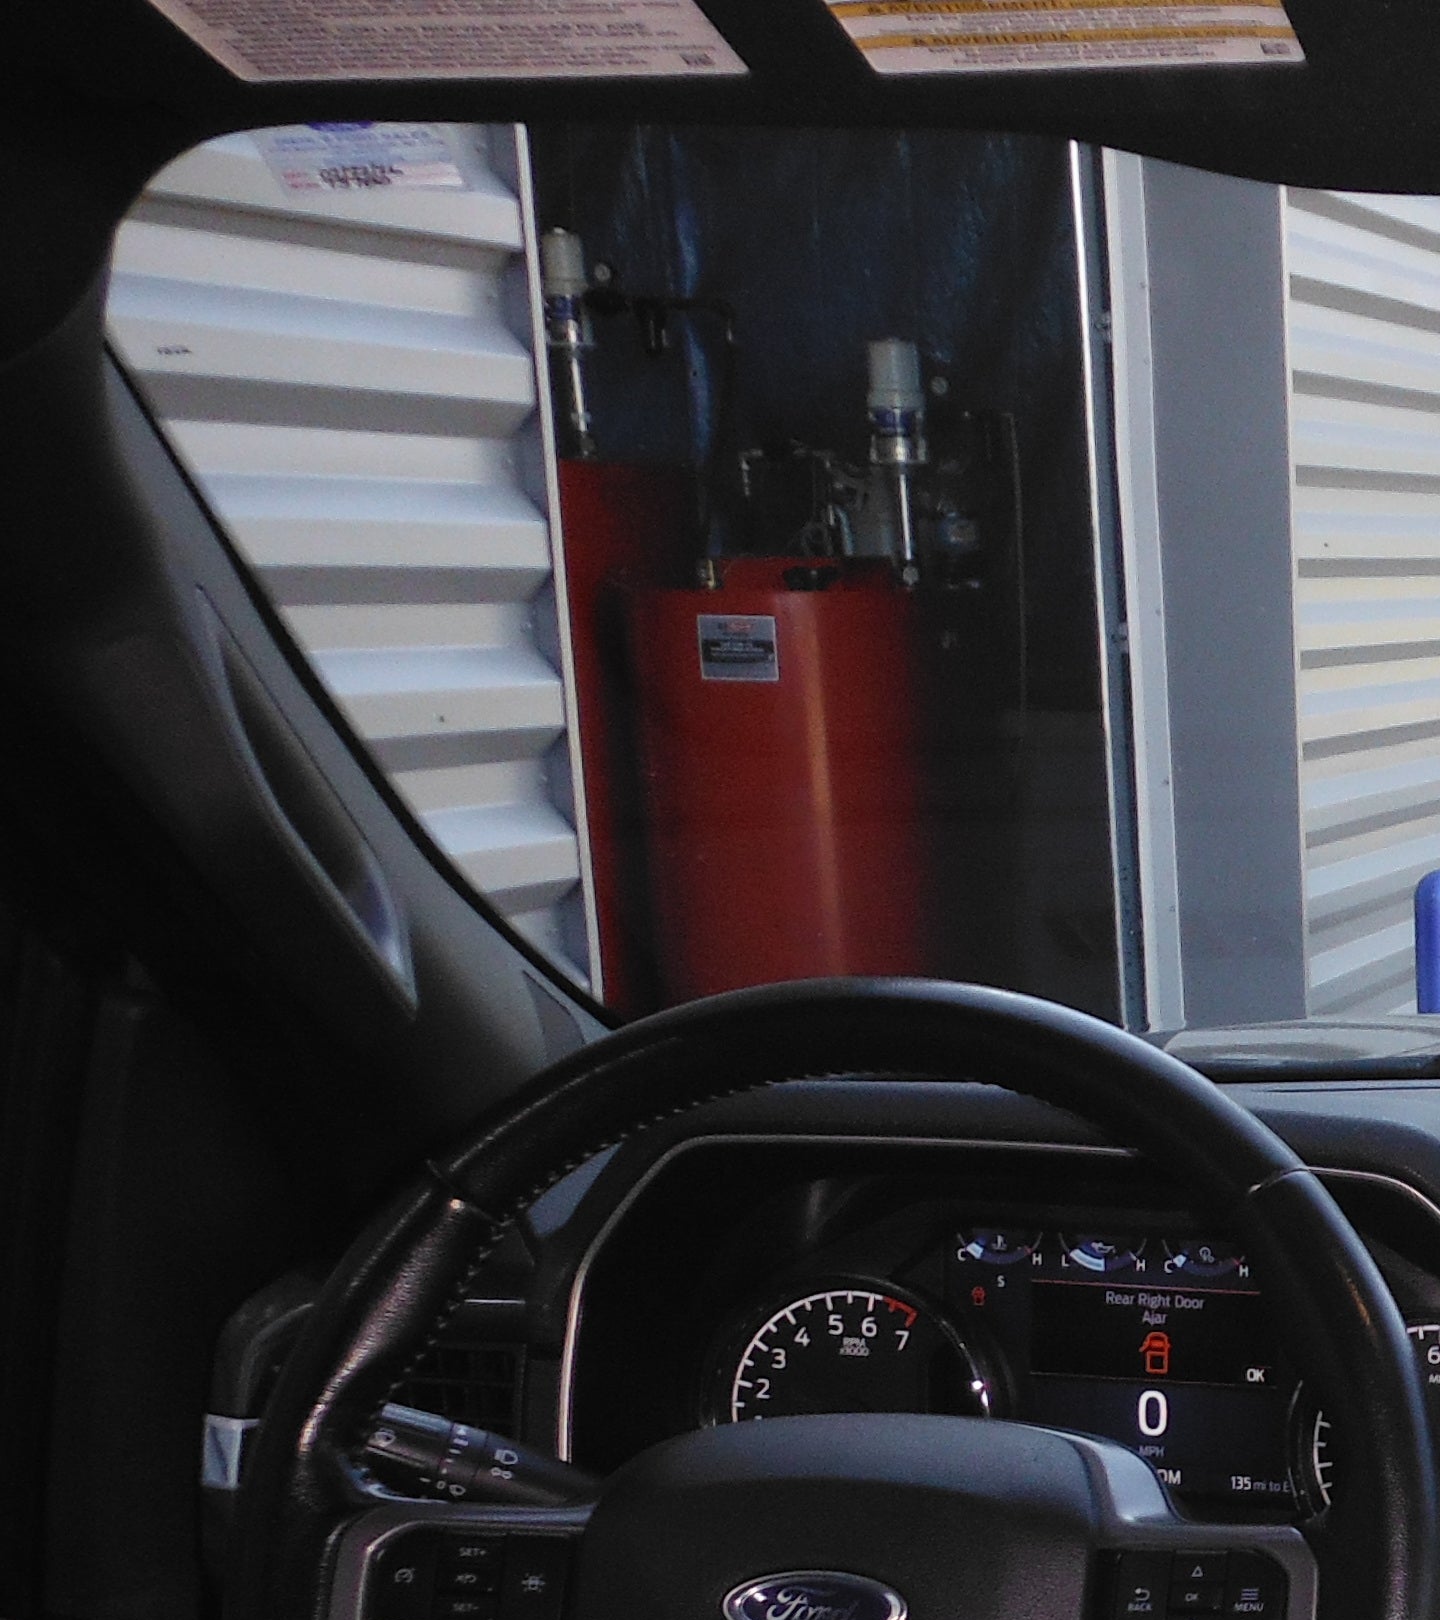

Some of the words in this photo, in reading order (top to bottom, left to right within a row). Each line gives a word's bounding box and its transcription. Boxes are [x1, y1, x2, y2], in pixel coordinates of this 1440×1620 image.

[957, 1248, 966, 1262] C
[1032, 1253, 1042, 1266] H
[1061, 1254, 1069, 1267] L
[1135, 1259, 1145, 1272] H
[1164, 1261, 1174, 1274] C
[1238, 1265, 1249, 1278] H
[1105, 1291, 1135, 1306] Rear
[1138, 1293, 1171, 1309] Right
[1174, 1294, 1205, 1310] Door
[828, 1315, 844, 1335] 5
[1142, 1310, 1167, 1327] Ajar
[861, 1316, 877, 1338] 6
[794, 1327, 810, 1347] 4
[843, 1337, 866, 1347] RPM
[895, 1330, 910, 1351] 7
[771, 1348, 787, 1369] 3
[1246, 1368, 1265, 1383] OK
[756, 1379, 770, 1399] 2
[1138, 1389, 1168, 1437] 0
[1139, 1445, 1165, 1458] MPH
[1230, 1476, 1252, 1491] 135
[1268, 1480, 1281, 1492] to
[1185, 1593, 1199, 1602] OK
[1127, 1603, 1153, 1612] BACK
[1234, 1603, 1264, 1612] MENU
